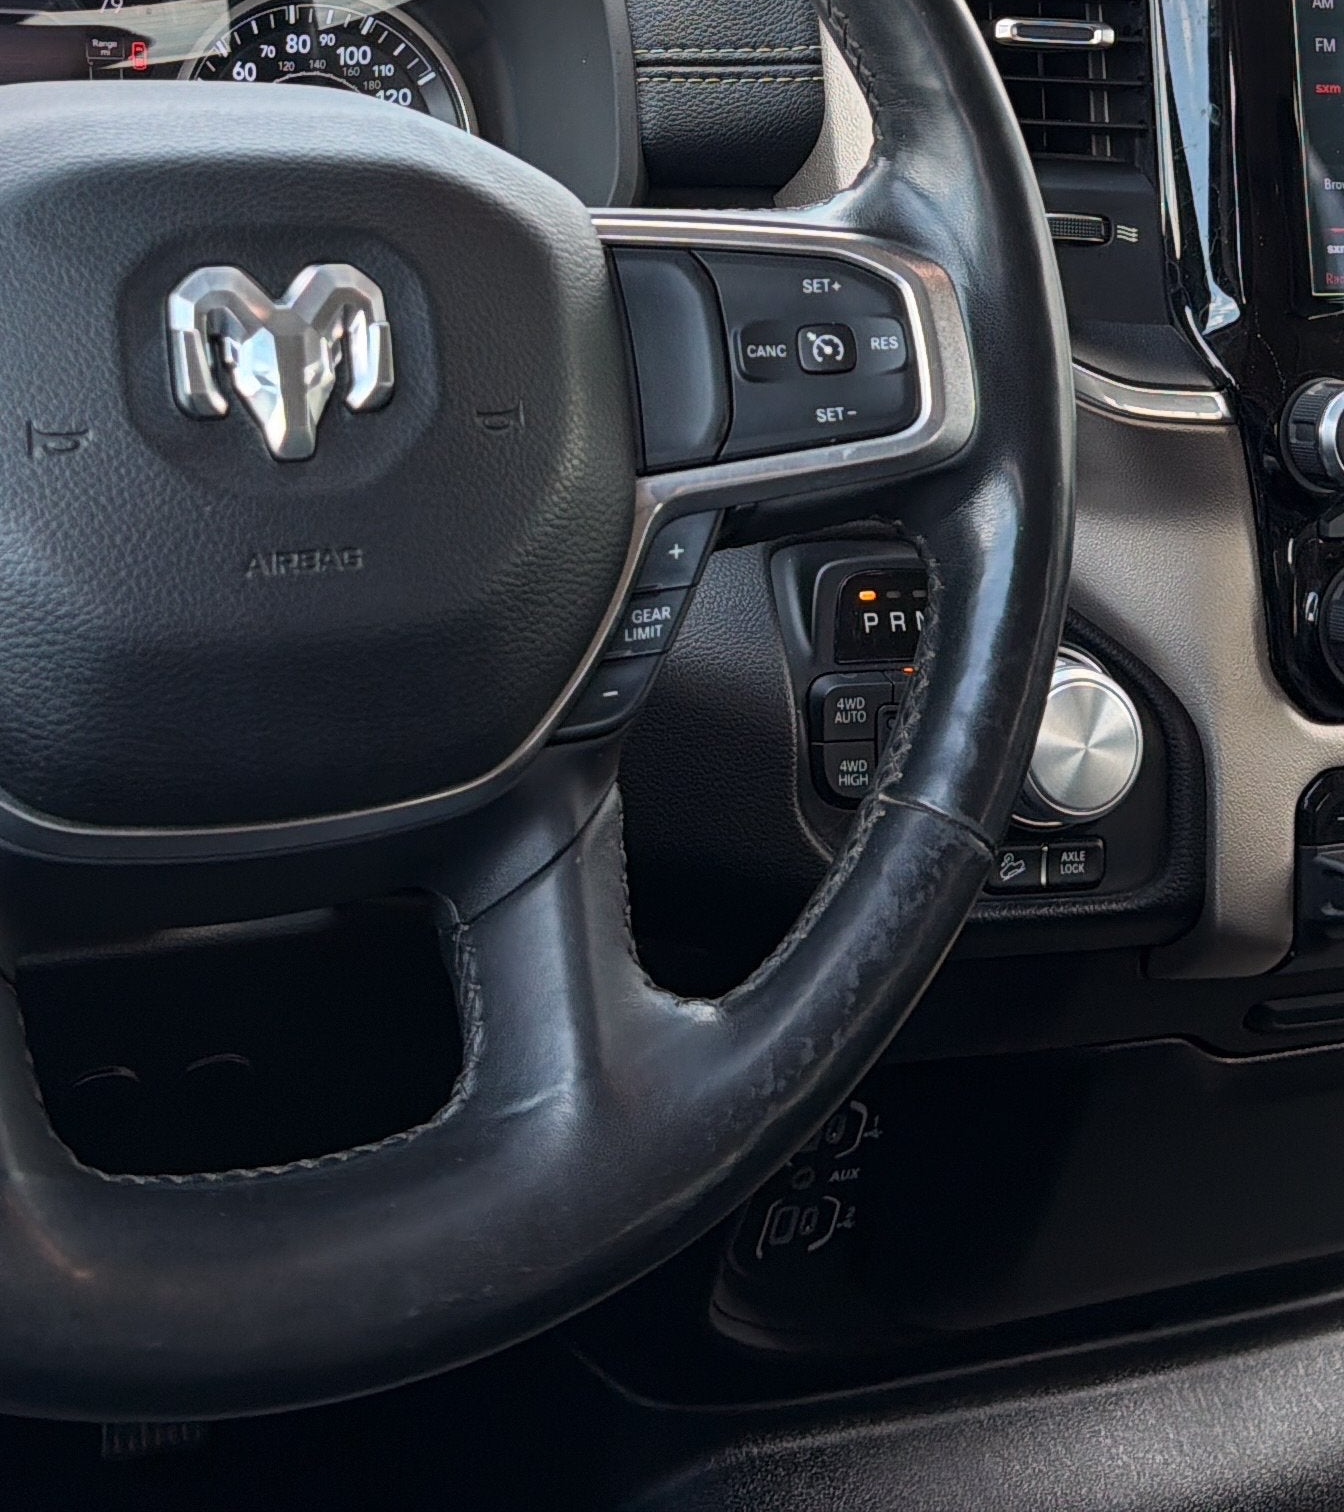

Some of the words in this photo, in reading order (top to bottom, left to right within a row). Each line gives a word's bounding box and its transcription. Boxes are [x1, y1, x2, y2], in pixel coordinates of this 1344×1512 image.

[285, 33, 311, 54] 80
[318, 33, 336, 47] 90
[1315, 38, 1336, 53] FM
[259, 44, 276, 59] 70
[336, 45, 372, 66] 100
[232, 61, 257, 82] 60
[277, 61, 296, 72] 120
[308, 59, 327, 70] 140
[342, 66, 360, 77] 160
[372, 63, 395, 78] 110
[363, 80, 382, 90] 180
[1315, 83, 1341, 94] sxm
[746, 342, 787, 359] CANC
[870, 336, 899, 351] RES
[244, 545, 364, 579] AIRBAG
[631, 606, 672, 624] GEAR
[863, 612, 879, 634] P
[889, 611, 907, 632] R
[624, 624, 663, 642] LIMIT
[836, 696, 866, 710] 4WD
[834, 710, 867, 724] AUTO
[839, 759, 868, 773] 4WD
[838, 774, 869, 786] HIGH
[1060, 850, 1086, 863] AXLE
[1059, 862, 1085, 875] LOCK
[829, 1167, 862, 1183] AUX
